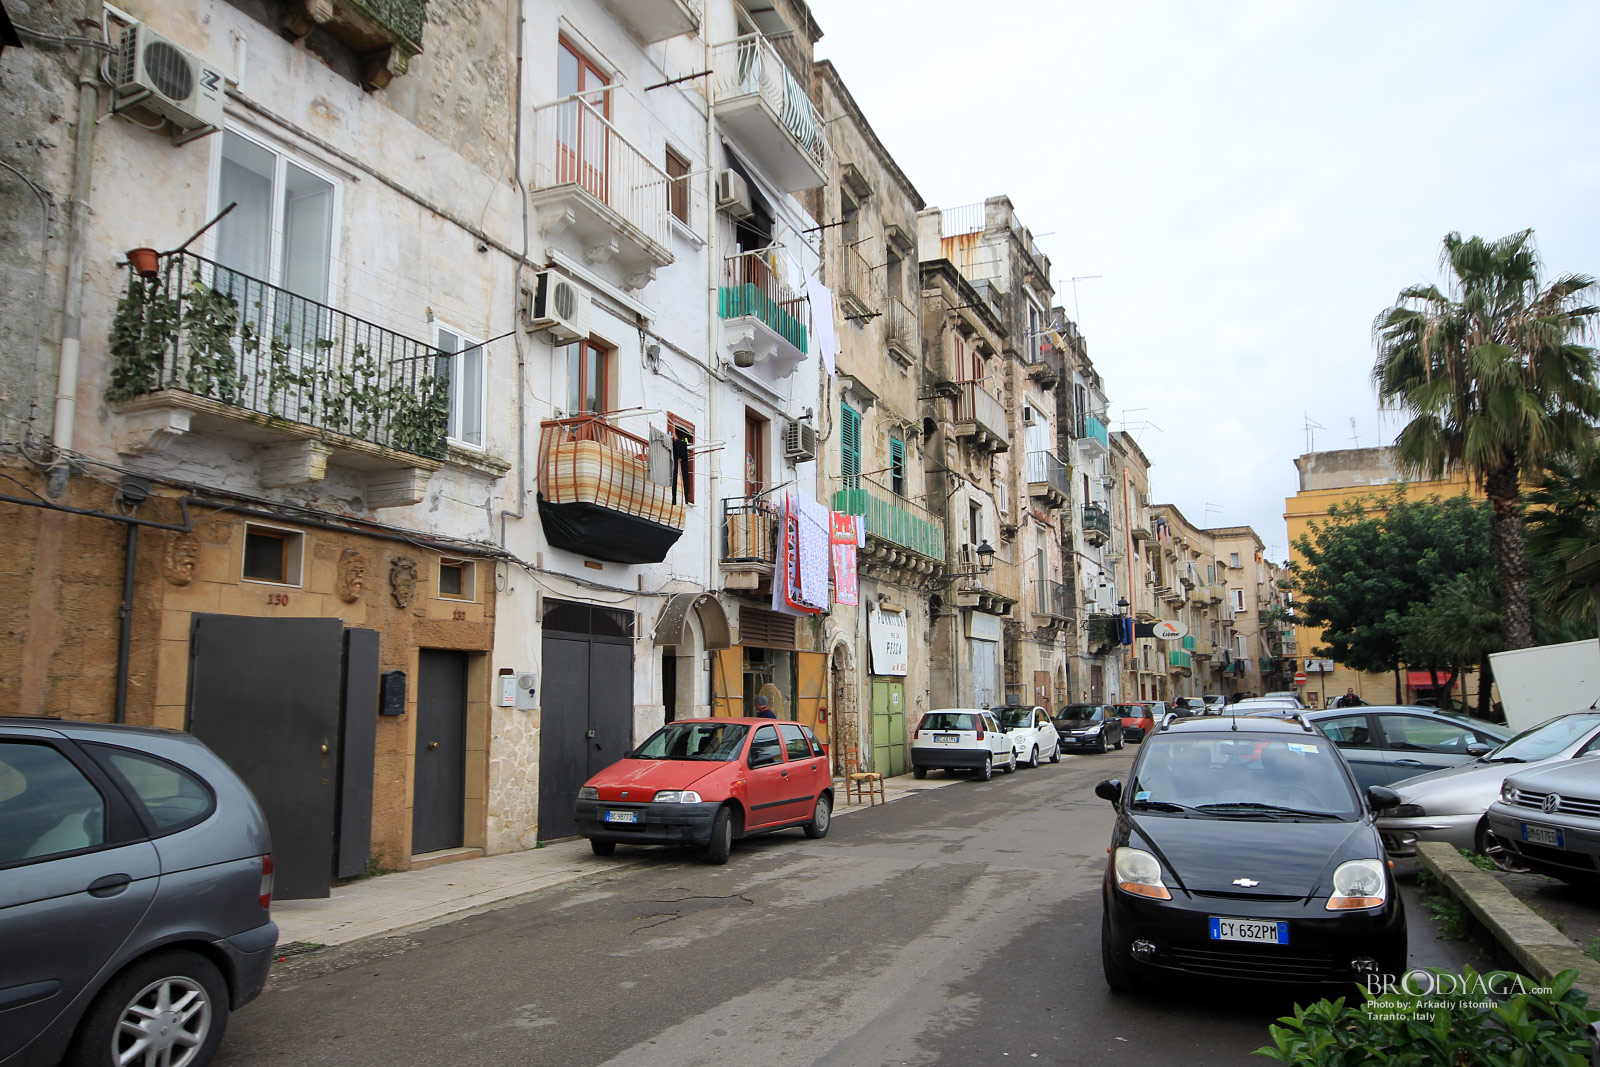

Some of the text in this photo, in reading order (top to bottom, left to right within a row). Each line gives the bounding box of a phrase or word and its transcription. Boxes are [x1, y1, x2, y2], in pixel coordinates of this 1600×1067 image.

[266, 592, 289, 607] 130
[886, 641, 902, 656] PESCA
[1220, 922, 1278, 940] CY 632PM
